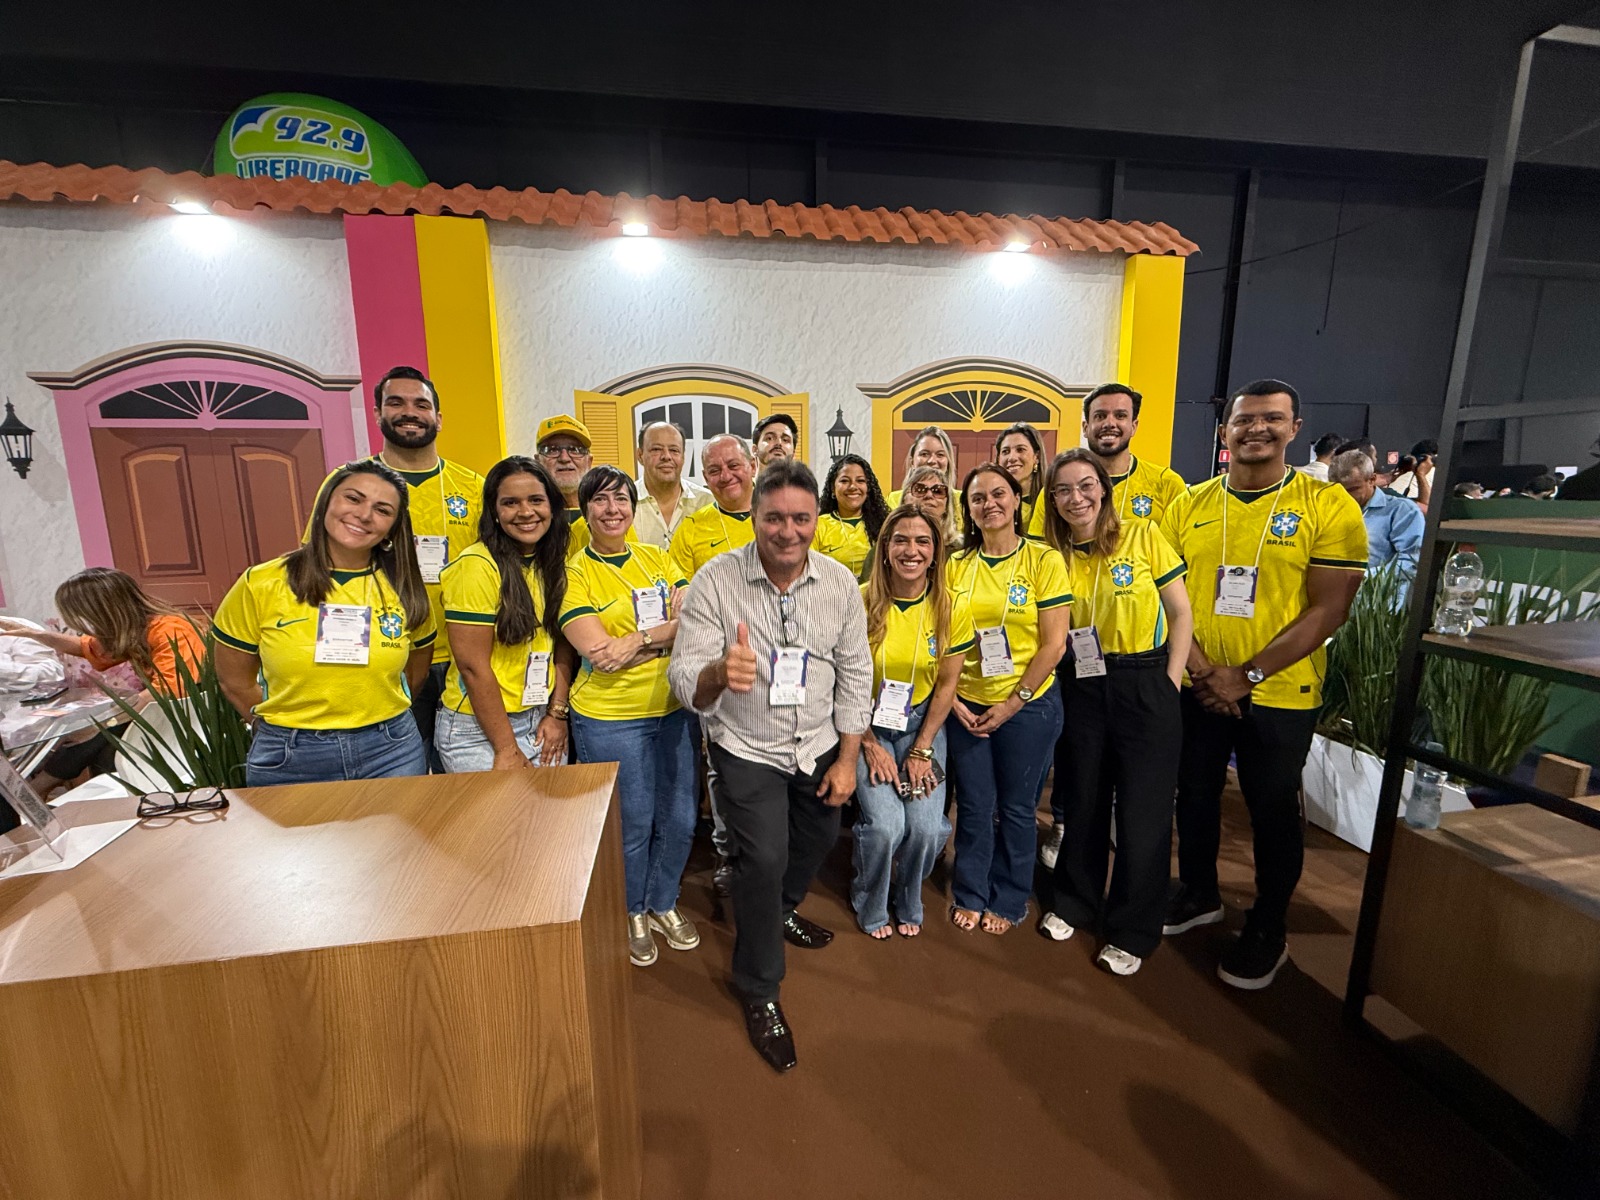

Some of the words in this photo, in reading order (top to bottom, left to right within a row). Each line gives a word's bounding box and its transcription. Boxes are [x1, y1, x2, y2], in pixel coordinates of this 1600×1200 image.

[275, 116, 367, 154] 92.9
[448, 519, 470, 527] BRASIL
[1266, 539, 1297, 547] BRASIL
[381, 641, 402, 649] BRASIL
